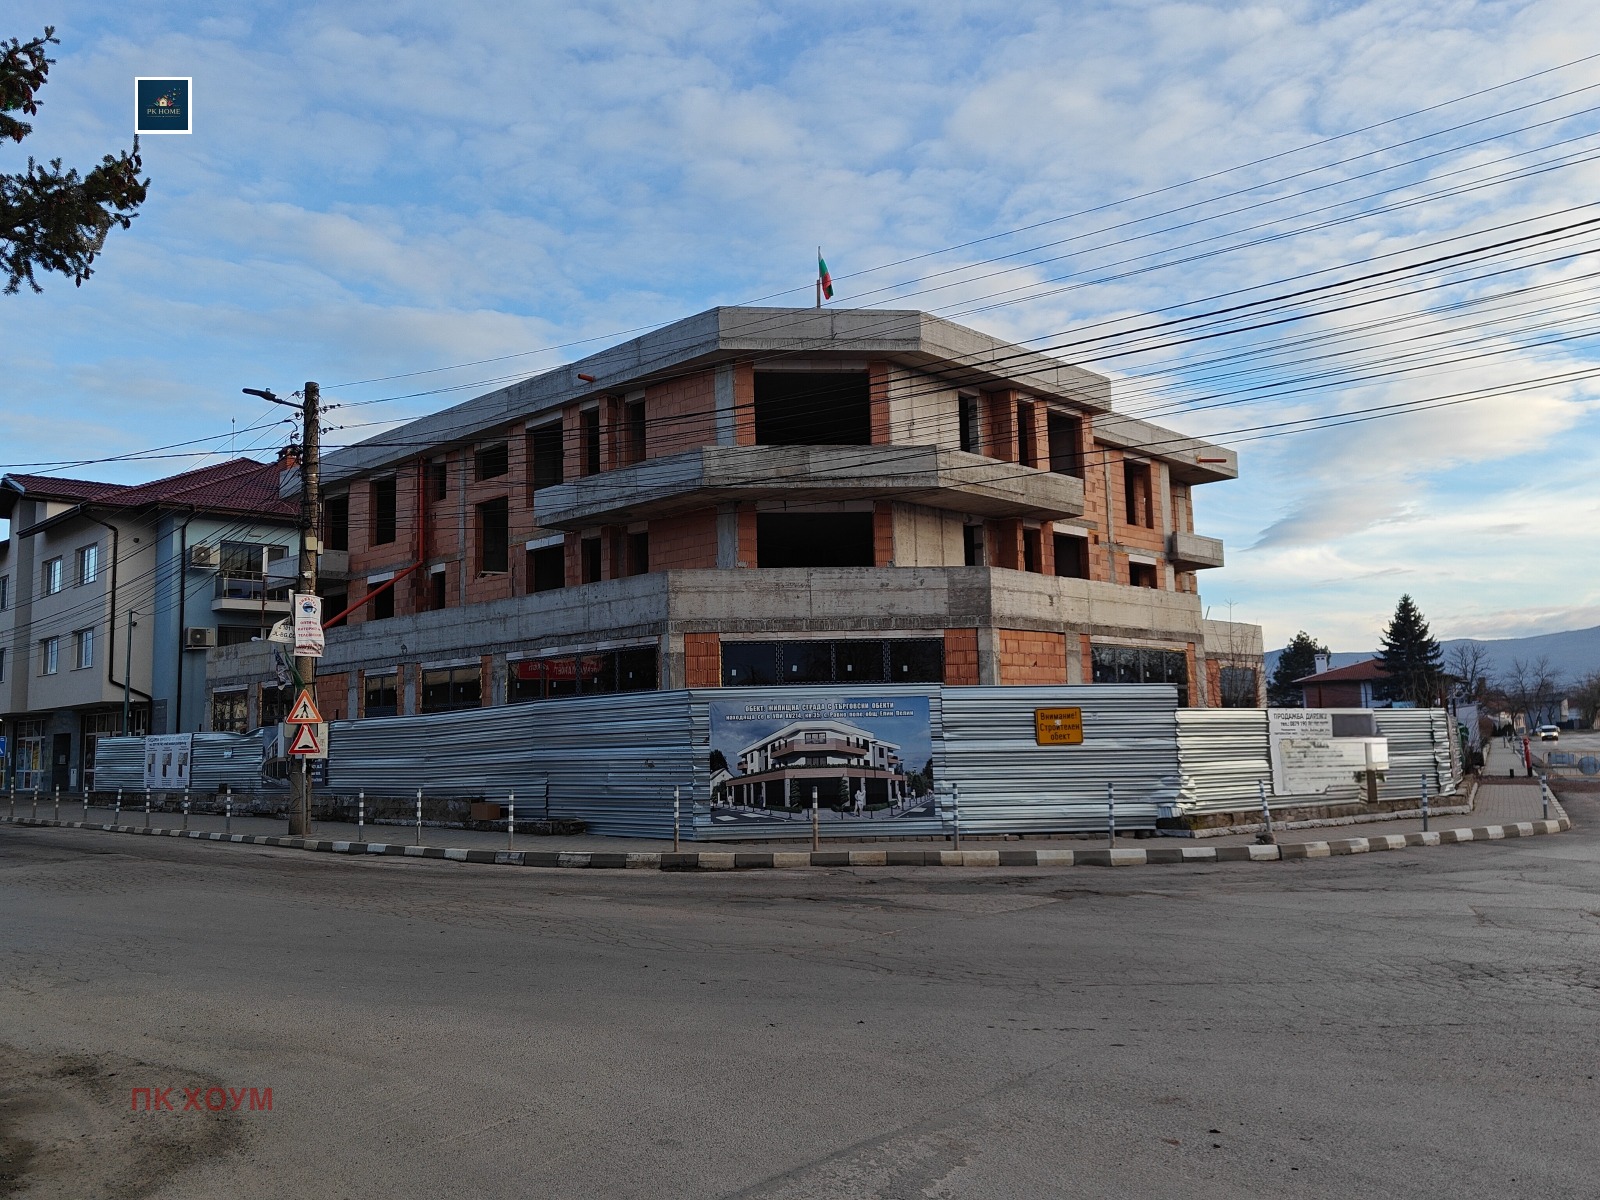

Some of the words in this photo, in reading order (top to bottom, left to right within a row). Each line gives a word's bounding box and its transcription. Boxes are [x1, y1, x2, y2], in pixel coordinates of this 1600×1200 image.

[768, 704, 800, 712] ЖИЛИЩНА
[1040, 712, 1077, 720] Внимание!
[1040, 723, 1080, 734] Строителен
[1050, 732, 1071, 740] обект
